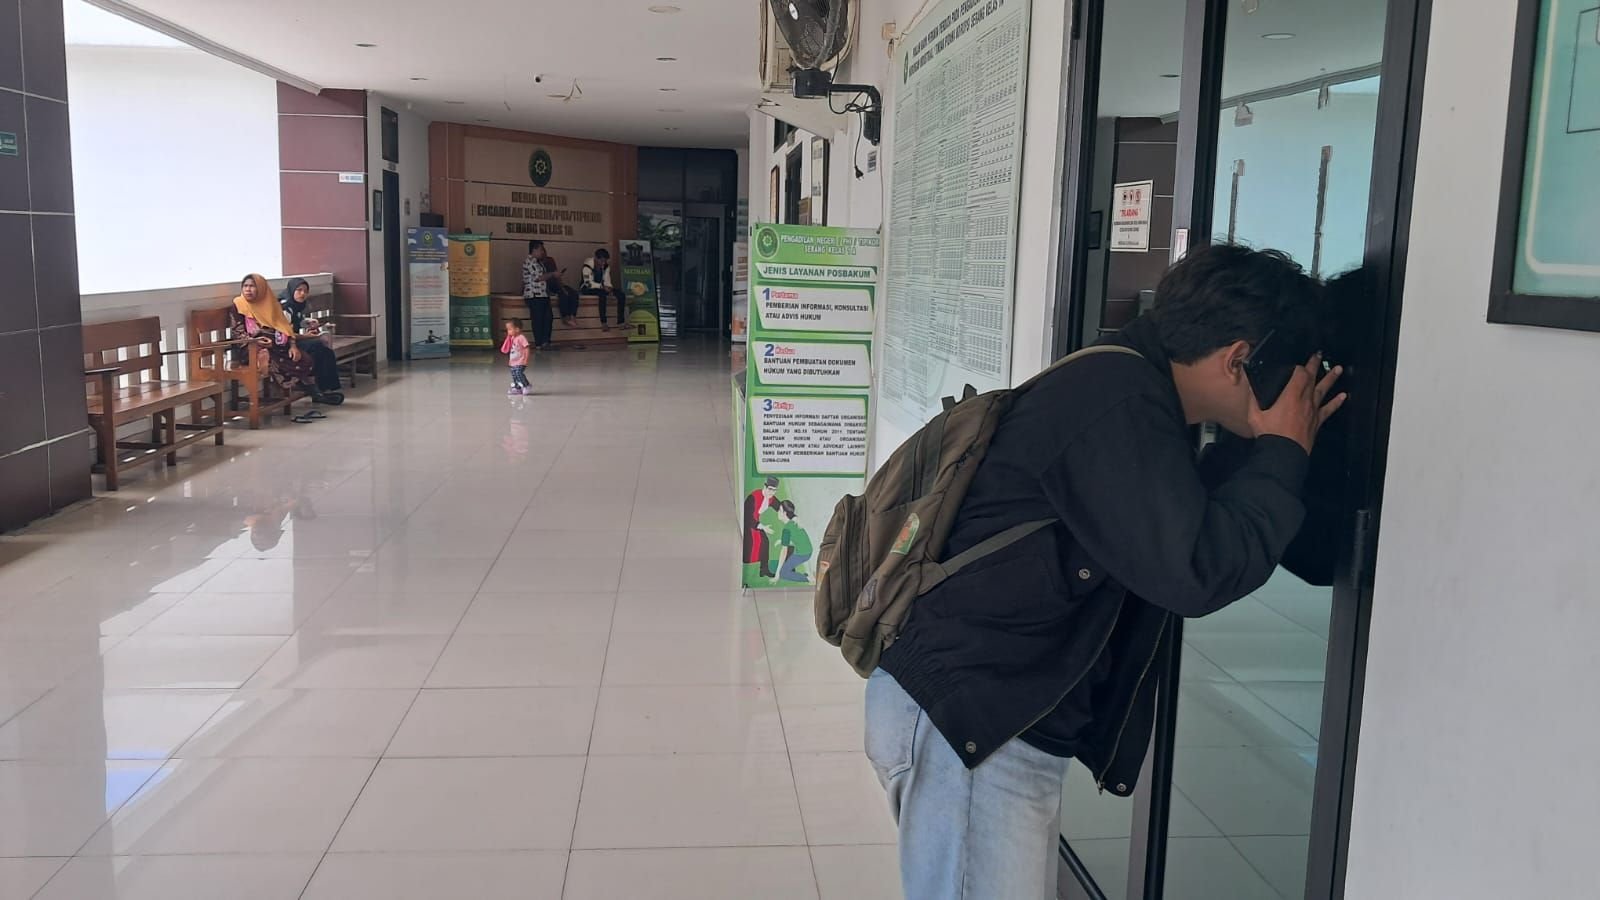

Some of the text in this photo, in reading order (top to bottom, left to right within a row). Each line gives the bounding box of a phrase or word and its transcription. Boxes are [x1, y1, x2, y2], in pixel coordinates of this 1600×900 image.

[539, 193, 567, 206] CENTER
[506, 222, 537, 234] SERANG
[539, 223, 563, 235] KELAS
[763, 266, 870, 279] JENIS LAYANAN POSBAKUM
[762, 287, 770, 300] 1
[766, 302, 869, 312] PEMBERIAN INFORMASI, KONSULTASI
[764, 344, 774, 357] 2
[793, 358, 826, 366] PEMBUATAN
[803, 368, 840, 376] DIBUTUHKAN
[763, 399, 772, 411] 3
